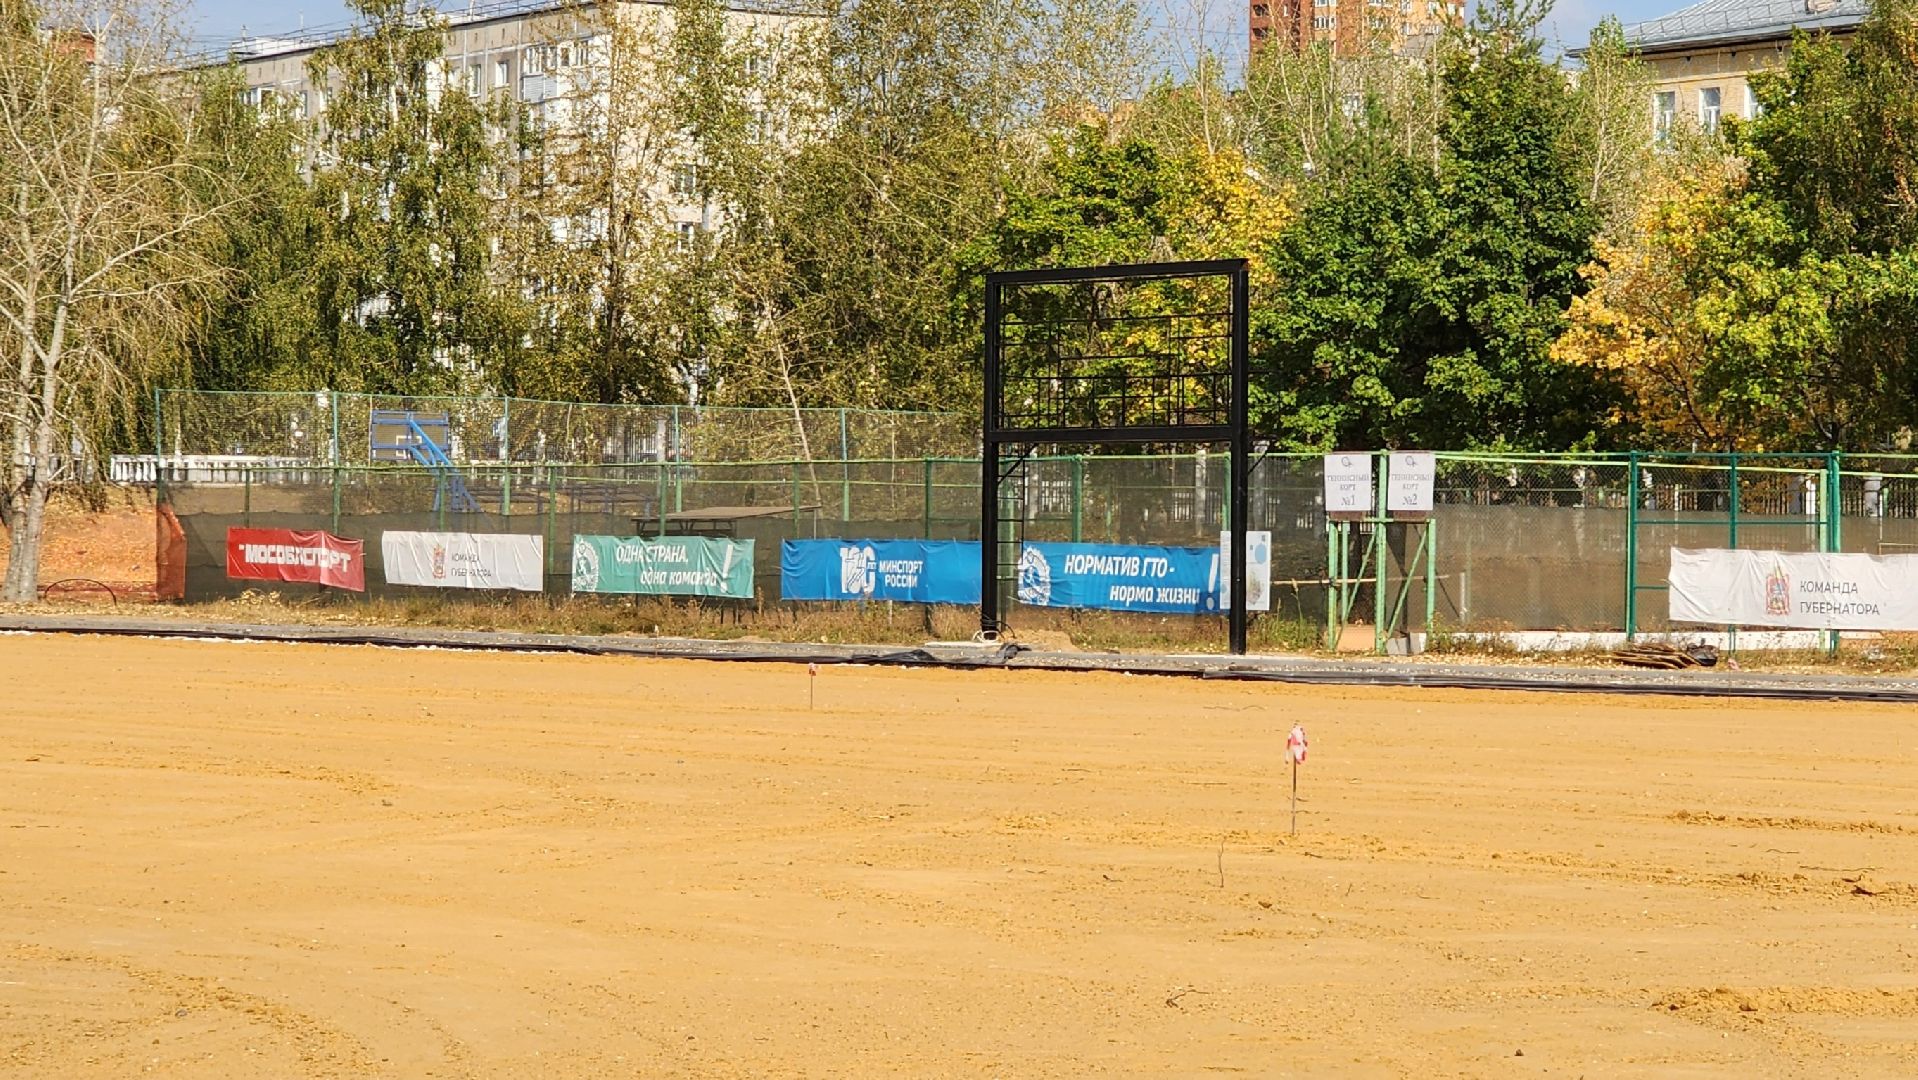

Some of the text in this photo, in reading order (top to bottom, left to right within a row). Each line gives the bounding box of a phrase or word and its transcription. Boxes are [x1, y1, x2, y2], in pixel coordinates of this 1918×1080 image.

[245, 544, 351, 572] МОСОБЛСПОРТ
[879, 560, 923, 574] МИНСПОРТ
[1064, 555, 1140, 576] НОРМАТИВ
[885, 575, 918, 588] РОССИИ
[1800, 581, 1858, 594] КОМАНДА
[1110, 586, 1200, 607] норма жизни
[1800, 602, 1880, 615] ГУБЕРНАТОРА
